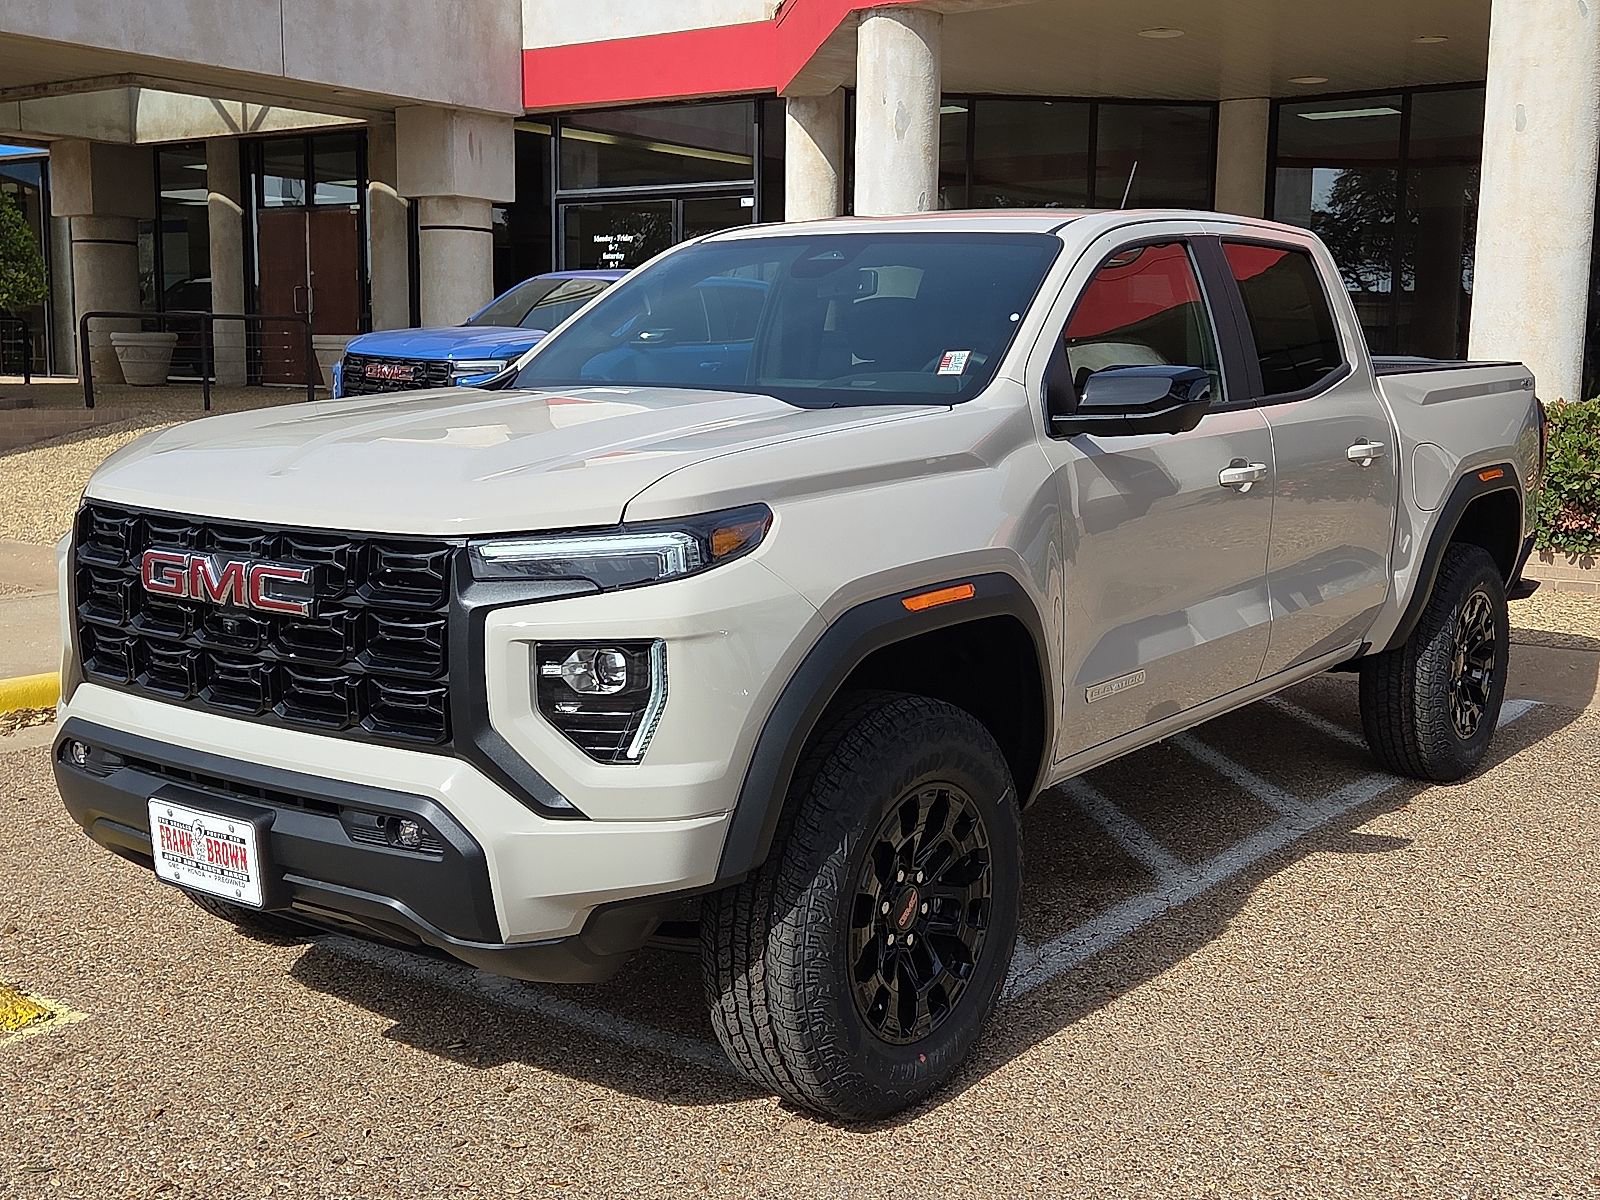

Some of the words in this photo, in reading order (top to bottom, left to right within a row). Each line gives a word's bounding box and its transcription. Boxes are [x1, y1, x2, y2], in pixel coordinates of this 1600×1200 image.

[593, 234, 613, 243] Monday
[617, 233, 634, 243] Friday
[602, 252, 625, 261] Saturday
[365, 364, 414, 381] GMC
[141, 549, 313, 618] GMC
[1091, 671, 1143, 697] ELEVATION
[159, 825, 195, 859] FRANK
[206, 838, 249, 873] BROWN
[168, 862, 181, 870] GMC
[187, 868, 206, 877] HONDA
[214, 875, 246, 888] PREOWNED
[898, 889, 917, 926] GMC
